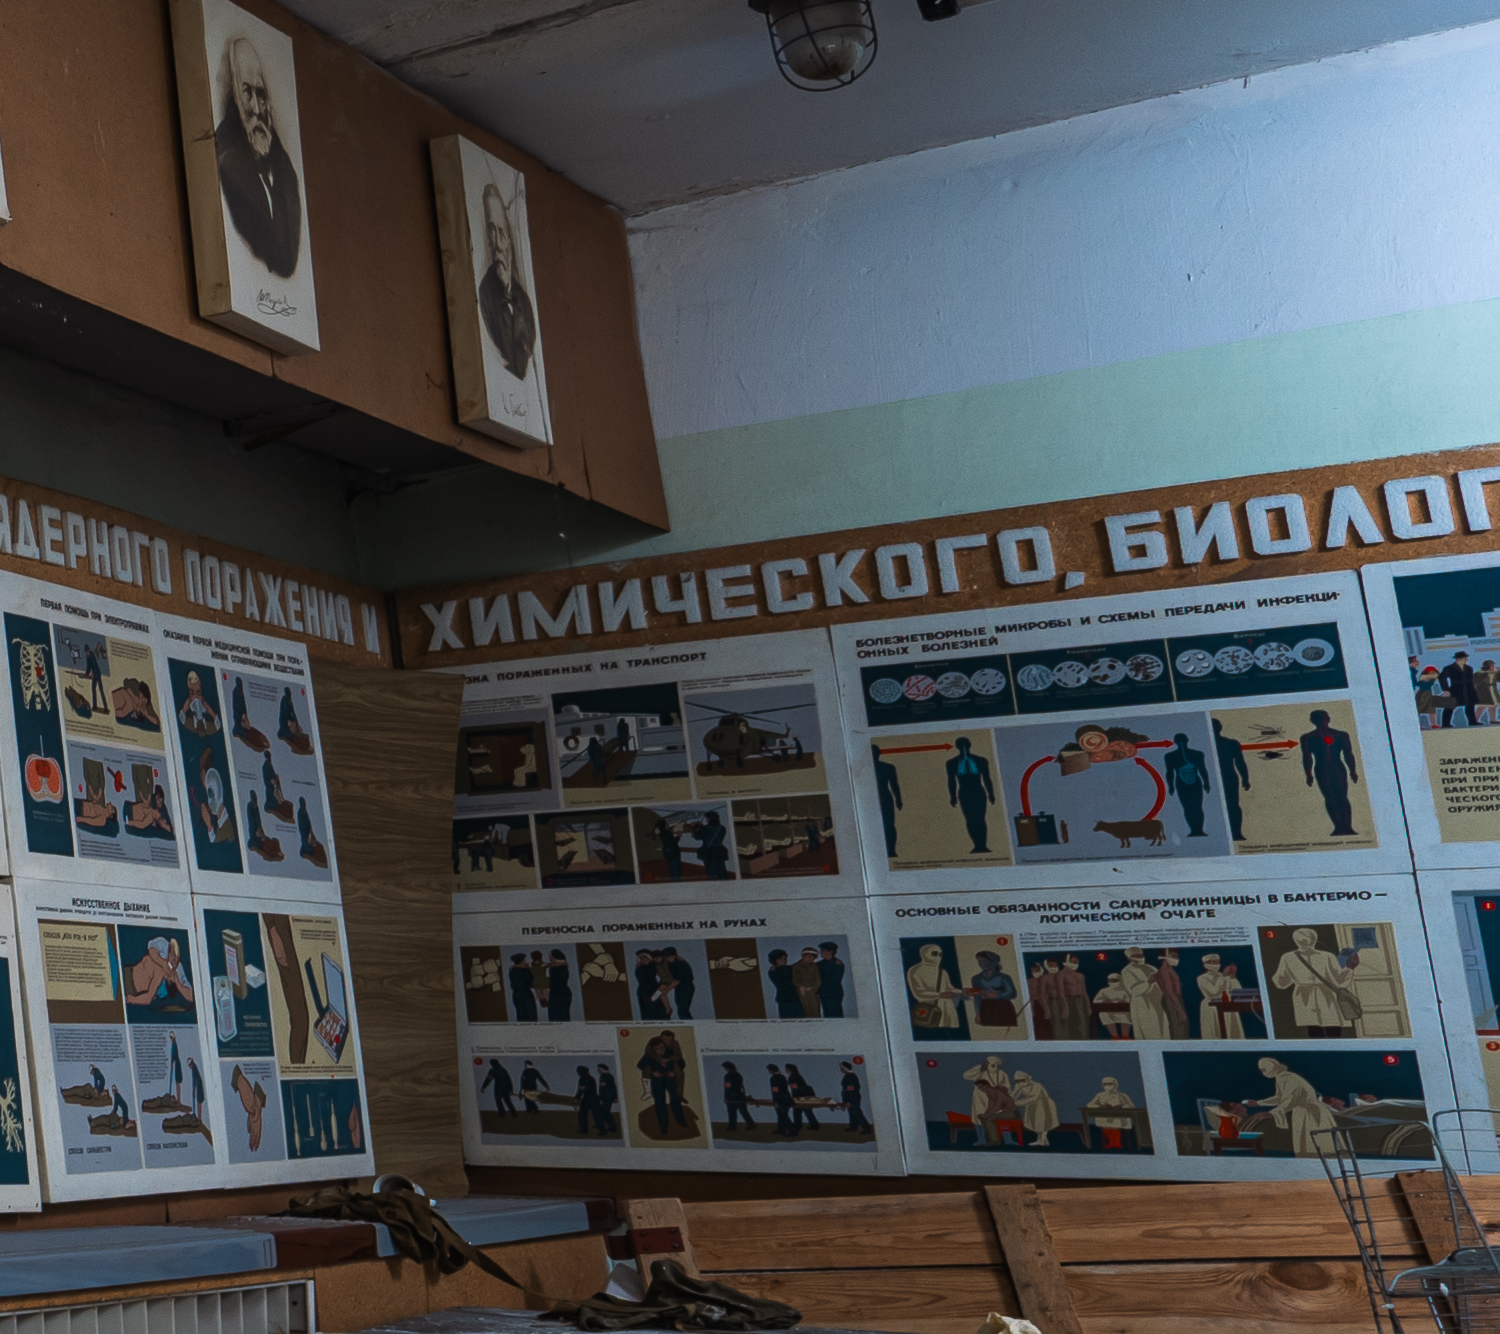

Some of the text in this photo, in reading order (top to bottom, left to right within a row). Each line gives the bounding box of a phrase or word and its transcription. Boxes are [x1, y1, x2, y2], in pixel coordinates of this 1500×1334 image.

[420, 466, 1500, 652] ХИМИЧЕСКОГО, БИОЛОГ
[184, 548, 355, 647] ПОРАЖЕНИЯ
[362, 603, 380, 654] И
[855, 626, 988, 649] БОЛЕЗНЕТВОРНЫЕ
[994, 618, 1072, 634] МИКРОБЫ
[1079, 615, 1092, 626] И
[1097, 609, 1156, 624] СХЕМЫ
[1164, 600, 1246, 618] ПЕРЕДАЧИ
[856, 636, 999, 660] ОННЫХ БОЛЕЗНЕЙ
[496, 663, 593, 682] ПОРАЖЕННЫХ
[599, 661, 620, 671] НА
[625, 651, 707, 668] ТРАНСПОРТ
[1441, 775, 1468, 785] ПРИ
[894, 905, 981, 918] ОСНОВНЫЕ
[986, 900, 1101, 915] ОБЯЗАННОСТИ
[1108, 894, 1261, 910] САНДРУЖИННИЦЫ
[1267, 894, 1279, 904] В
[1039, 908, 1216, 924] ЛОГИЧЕСКОМ ОЧАГЕ
[521, 918, 767, 936] ПЕРЕНОСКА ПОРАЖЕННЫХ НА РУКАХ
